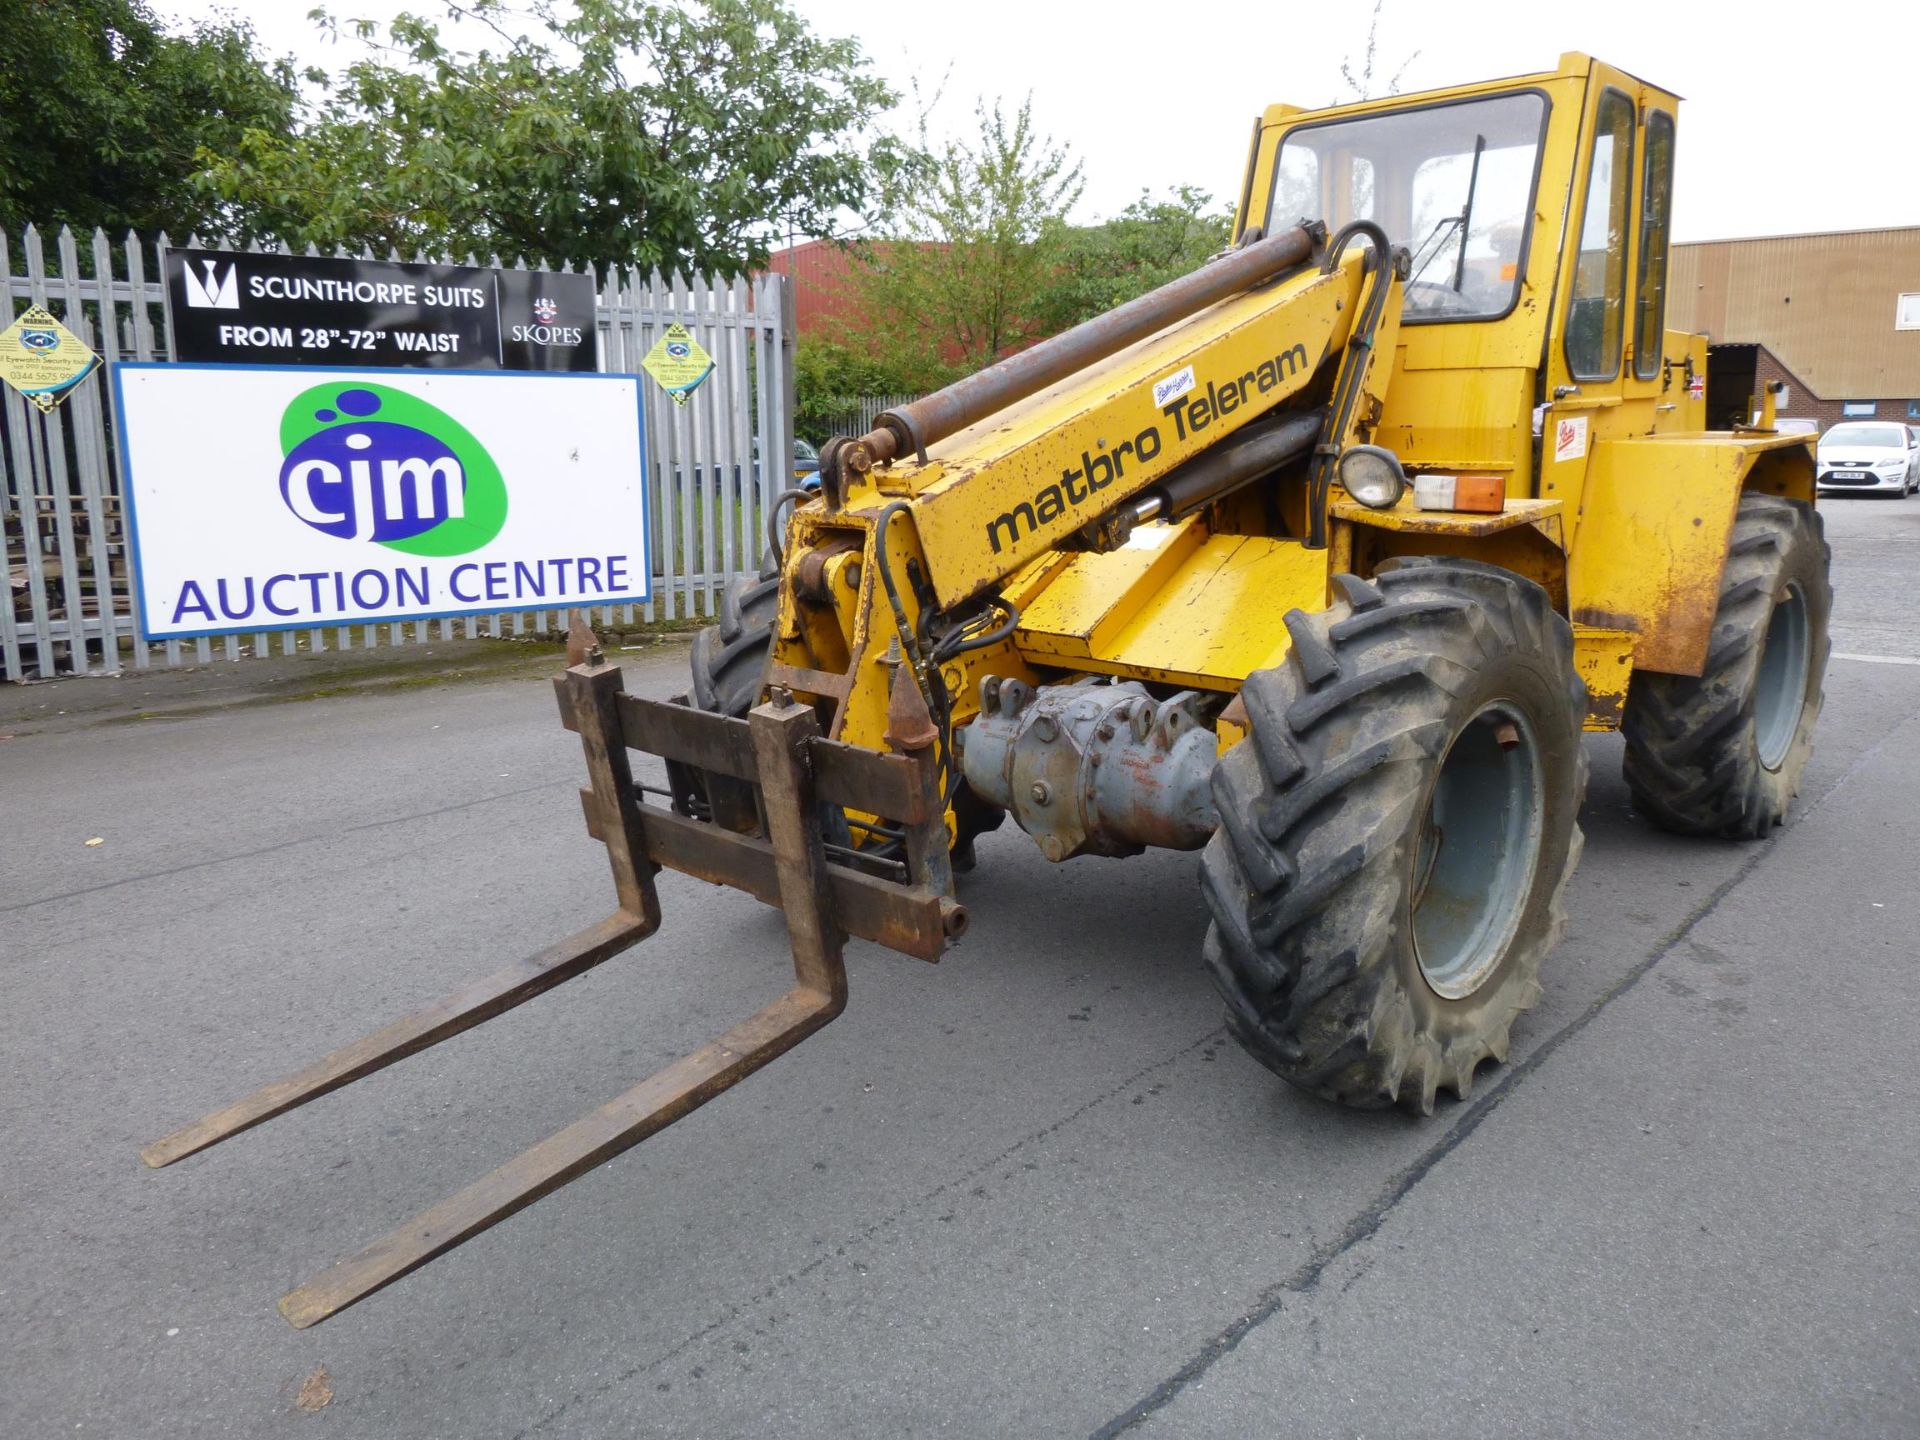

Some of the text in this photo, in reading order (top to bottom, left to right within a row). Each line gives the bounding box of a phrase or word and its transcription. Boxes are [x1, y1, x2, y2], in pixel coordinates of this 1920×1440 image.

[248, 275, 485, 309] SCUNTHORPE SUITS
[23, 317, 54, 325] WARNING
[512, 324, 582, 345] SKOPES
[220, 325, 293, 348] FROM
[394, 332, 460, 353] WAIST
[986, 343, 1308, 554] matbro Teleram
[287, 433, 465, 542] cjm
[171, 555, 629, 624] AUCTION CENTRE
